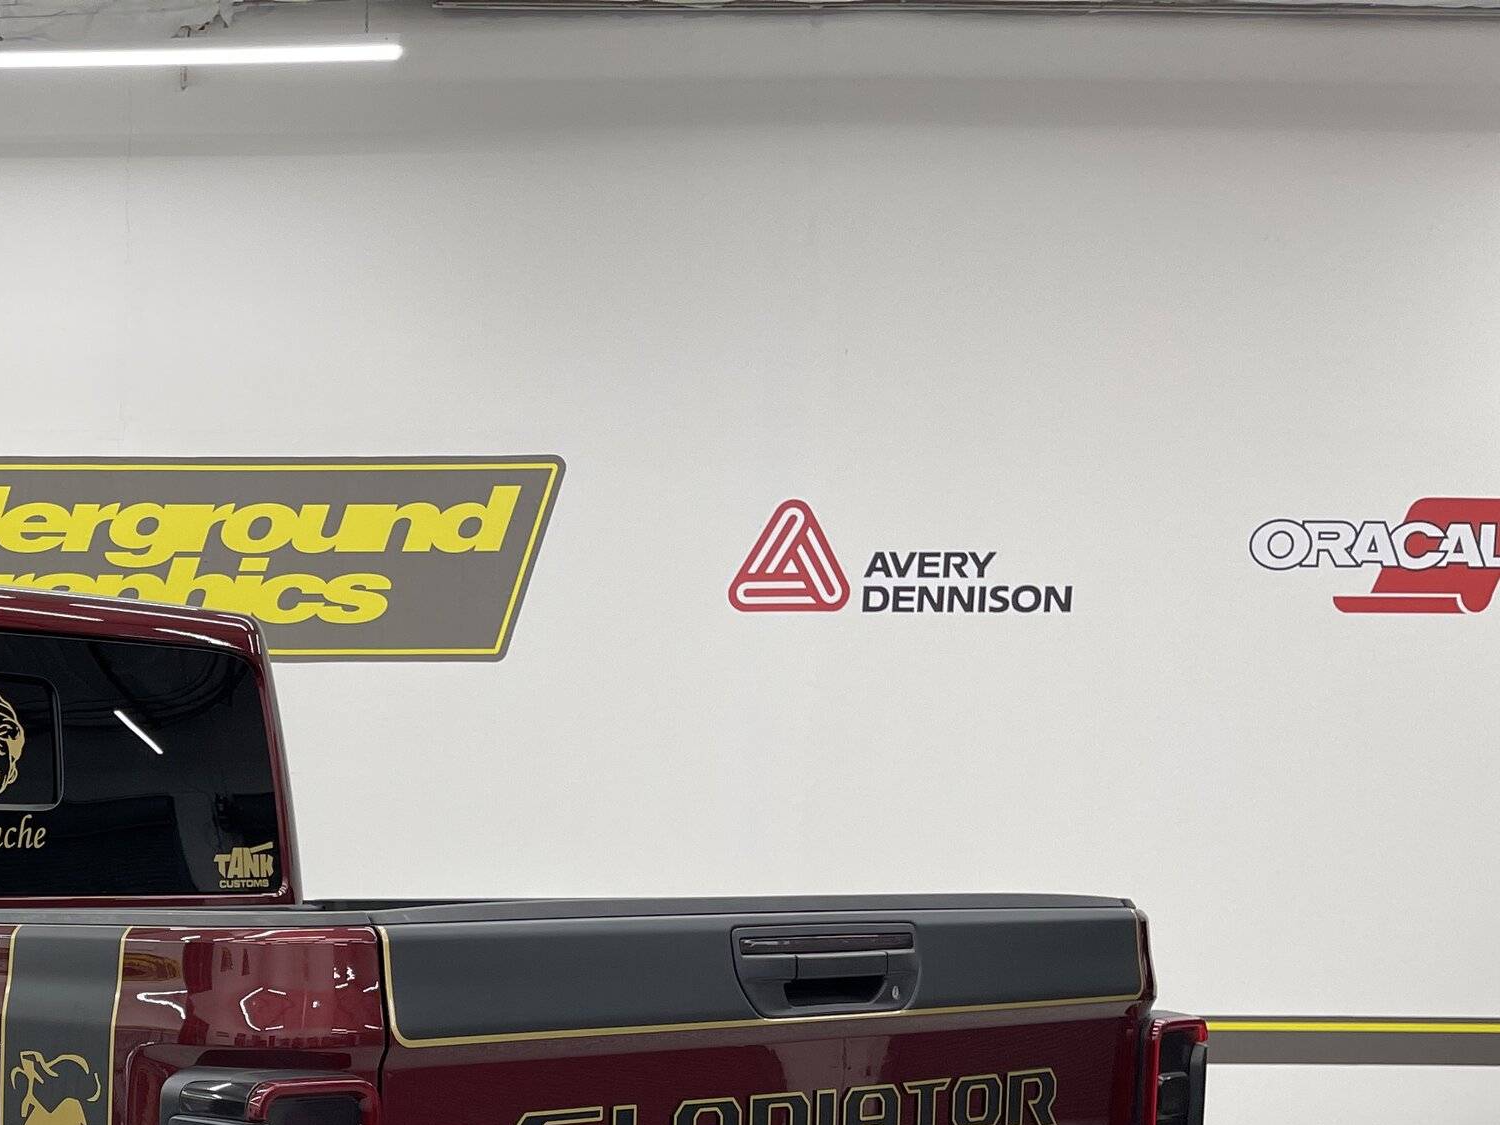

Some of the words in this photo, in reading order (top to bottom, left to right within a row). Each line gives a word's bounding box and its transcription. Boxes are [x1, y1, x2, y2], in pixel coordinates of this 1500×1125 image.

[1250, 519, 1500, 571] ORACAL
[864, 551, 997, 579] AVERY
[862, 586, 1073, 613] DENNISON
[213, 841, 274, 879] TANK
[219, 879, 269, 888] CUSTOMS
